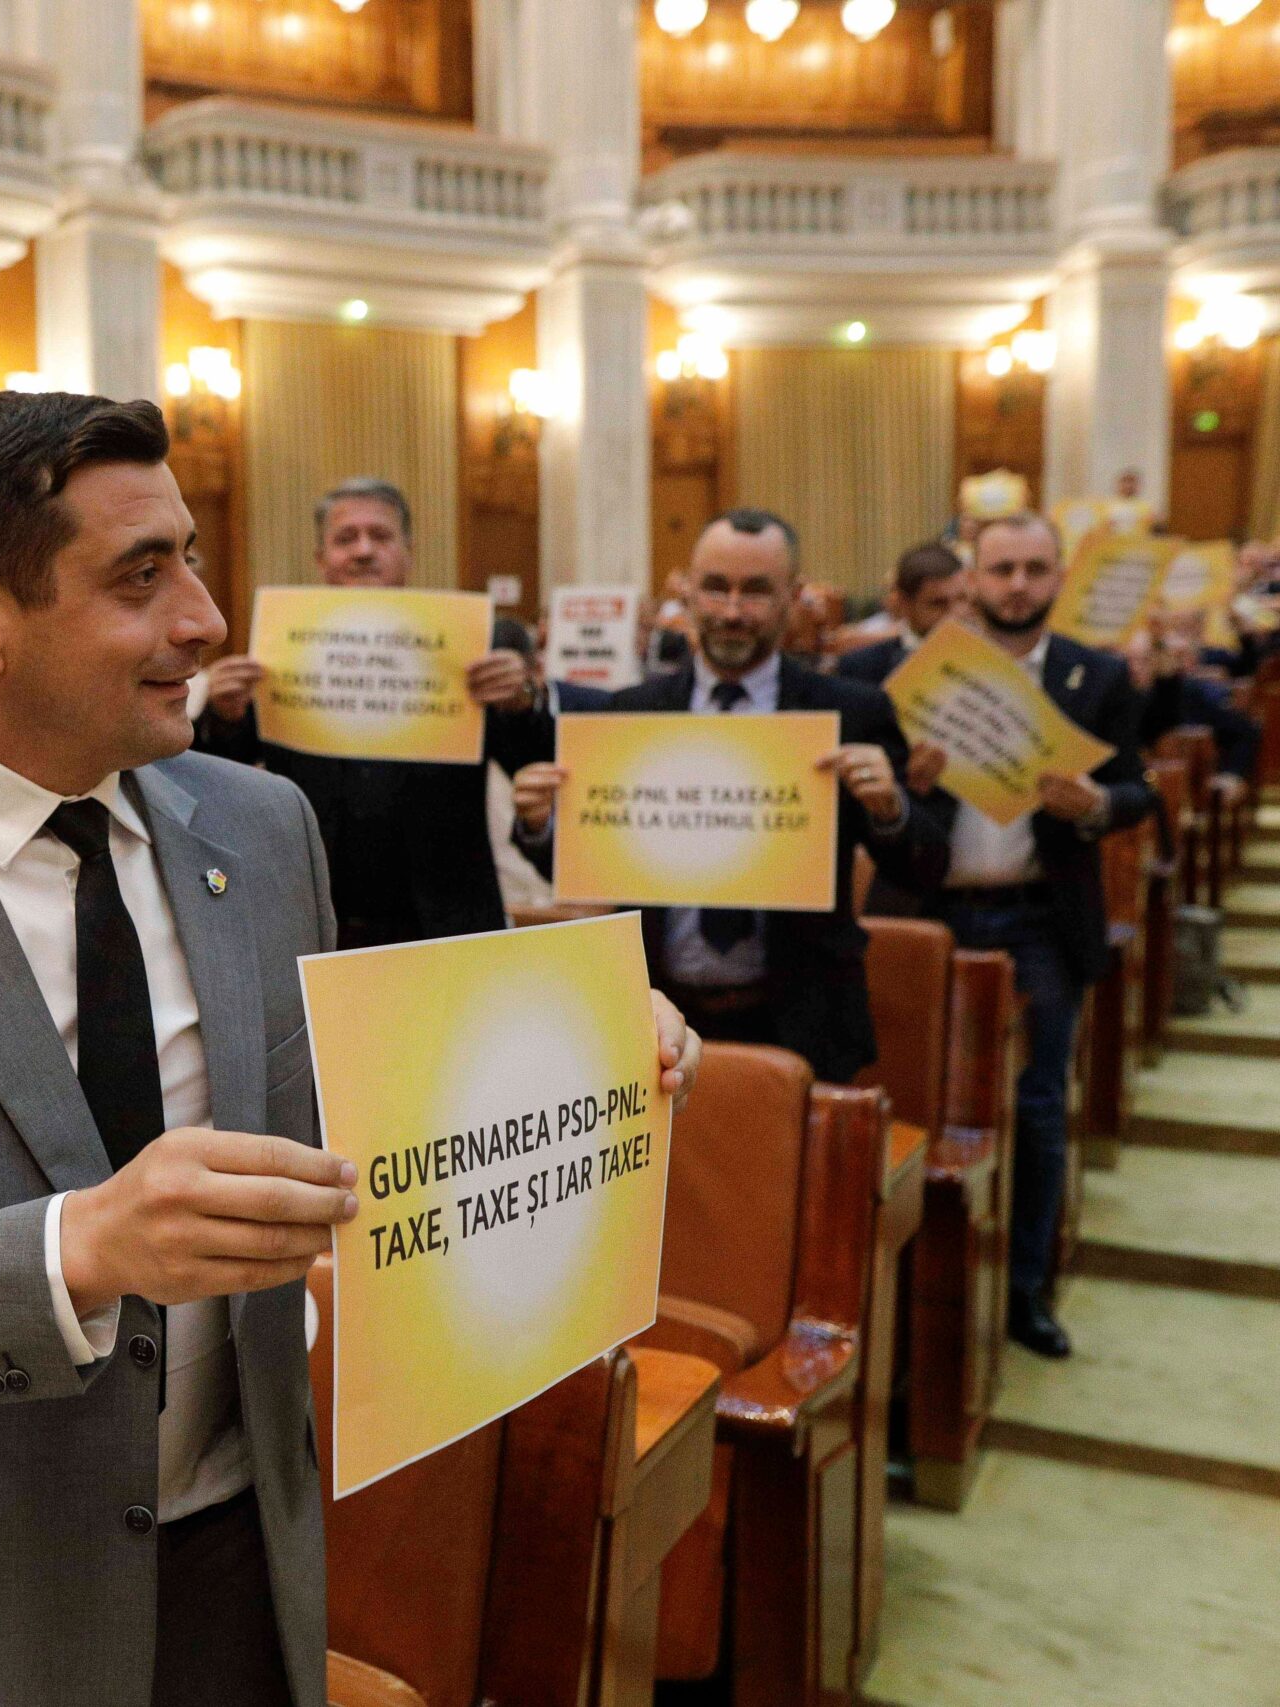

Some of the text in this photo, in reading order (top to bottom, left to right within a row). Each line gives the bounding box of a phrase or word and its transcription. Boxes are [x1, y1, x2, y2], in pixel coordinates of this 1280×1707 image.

[638, 811, 663, 830] LA
[668, 810, 755, 831] ULTIMUL
[676, 785, 701, 803] NE
[370, 1081, 647, 1200] GUVERNAREA PSD-PNL:
[369, 1132, 651, 1270] TAXE, TAXE ȘI IAR TAXE!
